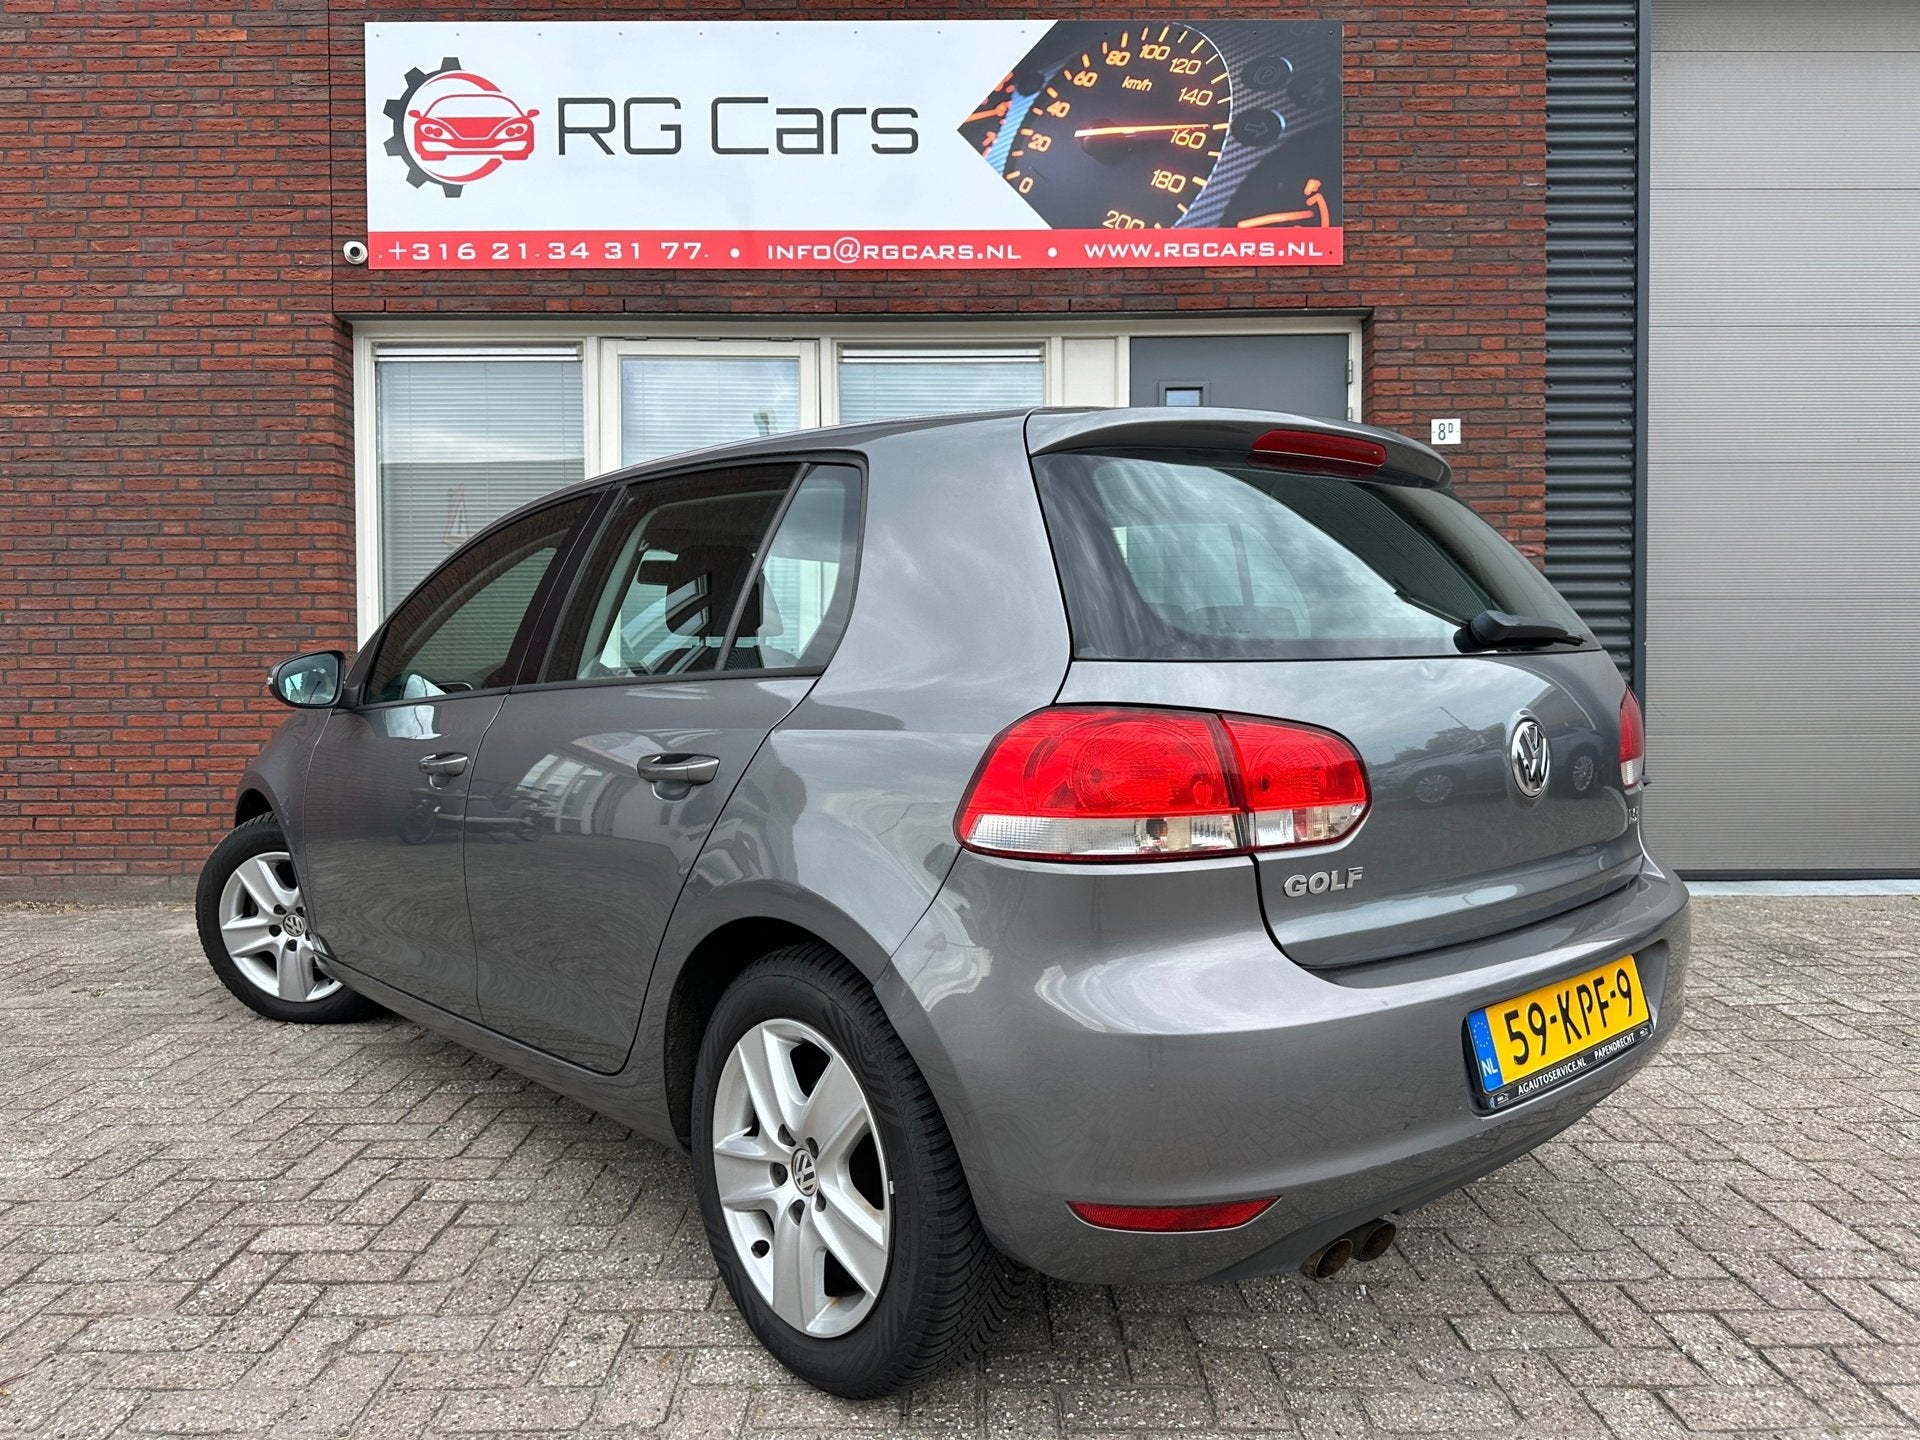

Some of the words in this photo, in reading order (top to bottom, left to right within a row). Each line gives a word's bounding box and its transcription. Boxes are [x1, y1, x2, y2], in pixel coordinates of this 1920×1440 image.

[1105, 50, 1131, 66] 80
[1139, 44, 1170, 60] 100
[1169, 57, 1201, 75] 120
[1073, 70, 1098, 87] 60
[1122, 76, 1152, 92] km/h
[1178, 87, 1213, 106] 140
[1046, 101, 1070, 118] 40
[557, 97, 682, 155] RG
[711, 96, 919, 155] Cars
[1027, 133, 1052, 152] 20
[1170, 129, 1206, 149] 160
[1018, 176, 1034, 194] 0
[1150, 169, 1186, 193] 180
[1102, 209, 1145, 229] 200
[388, 241, 476, 261] +316
[491, 242, 527, 260] 21
[547, 242, 589, 260] 34
[604, 242, 640, 260] 31
[660, 242, 702, 260] 77
[767, 236, 1022, 264] INFO@RGCARS.NL
[1084, 242, 1323, 258] WWW.RGCARS.NL
[1283, 866, 1364, 897] GOLF
[1503, 968, 1633, 1065] 59-KPF-9
[1480, 1057, 1498, 1077] NL
[1517, 1055, 1587, 1096] AGAUTOSERVICE.NL
[1593, 1032, 1635, 1060] PAPENDRECHT
